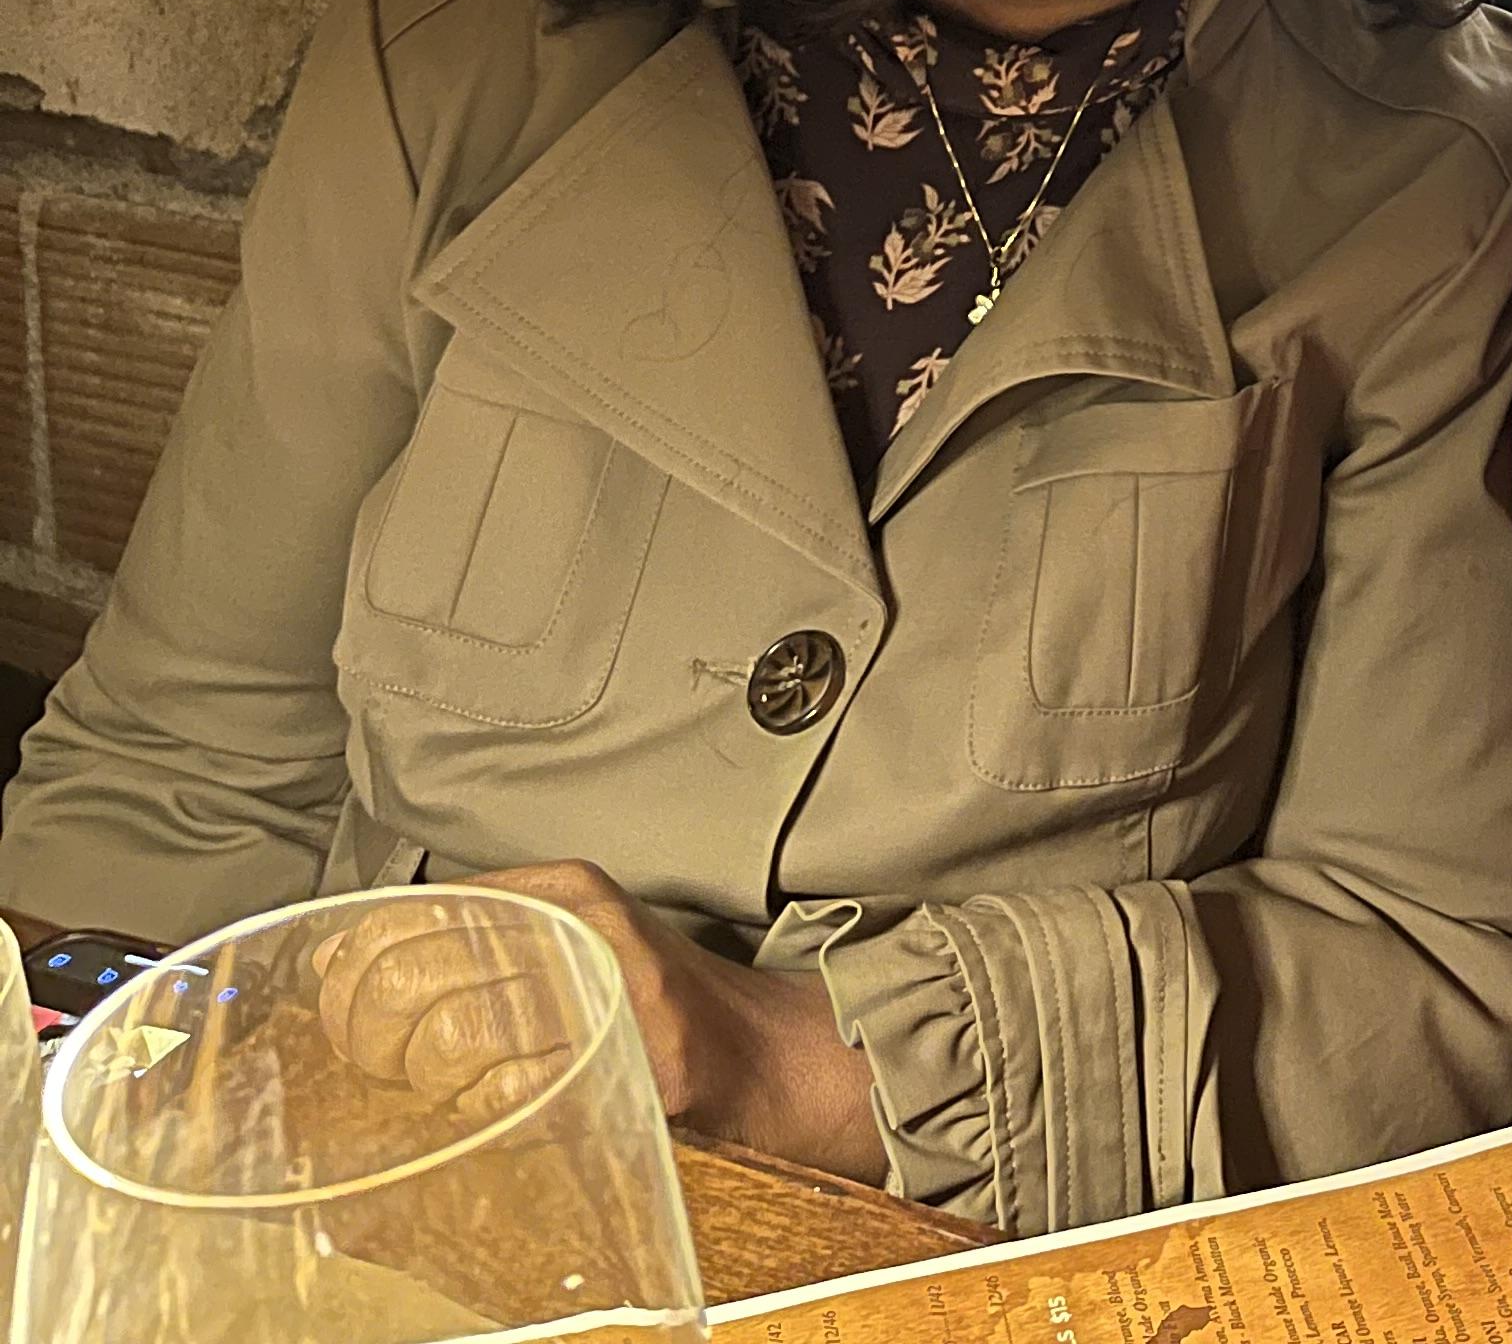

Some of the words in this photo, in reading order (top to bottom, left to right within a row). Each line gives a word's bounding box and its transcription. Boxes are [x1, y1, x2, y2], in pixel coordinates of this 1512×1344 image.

[1371, 1191, 1394, 1220] Made
[1393, 1192, 1414, 1223] Water
[1432, 1172, 1462, 1215] Campari
[1318, 1217, 1339, 1257] Lemon,
[1386, 1221, 1409, 1251] House
[1408, 1222, 1438, 1268] Sparkling
[1207, 1236, 1234, 1297] Manhattan
[1252, 1236, 1278, 1283] Organic
[1279, 1247, 1306, 1299] Prosecco
[1332, 1258, 1355, 1298] Liquor,
[1101, 1270, 1124, 1304] Blood
[1125, 1265, 1149, 1312] Organic
[1479, 1264, 1502, 1295] Sweet
[1048, 1295, 1073, 1324] $15
[1223, 1299, 1246, 1330] Black
[1268, 1286, 1290, 1316] Made
[1300, 1300, 1321, 1339] Lemon,
[1347, 1299, 1371, 1337] Orange
[1415, 1281, 1440, 1324] Orange,
[1116, 1307, 1135, 1344] range,
[1282, 1318, 1301, 1344] ouse
[1445, 1303, 1471, 1343] Orange
